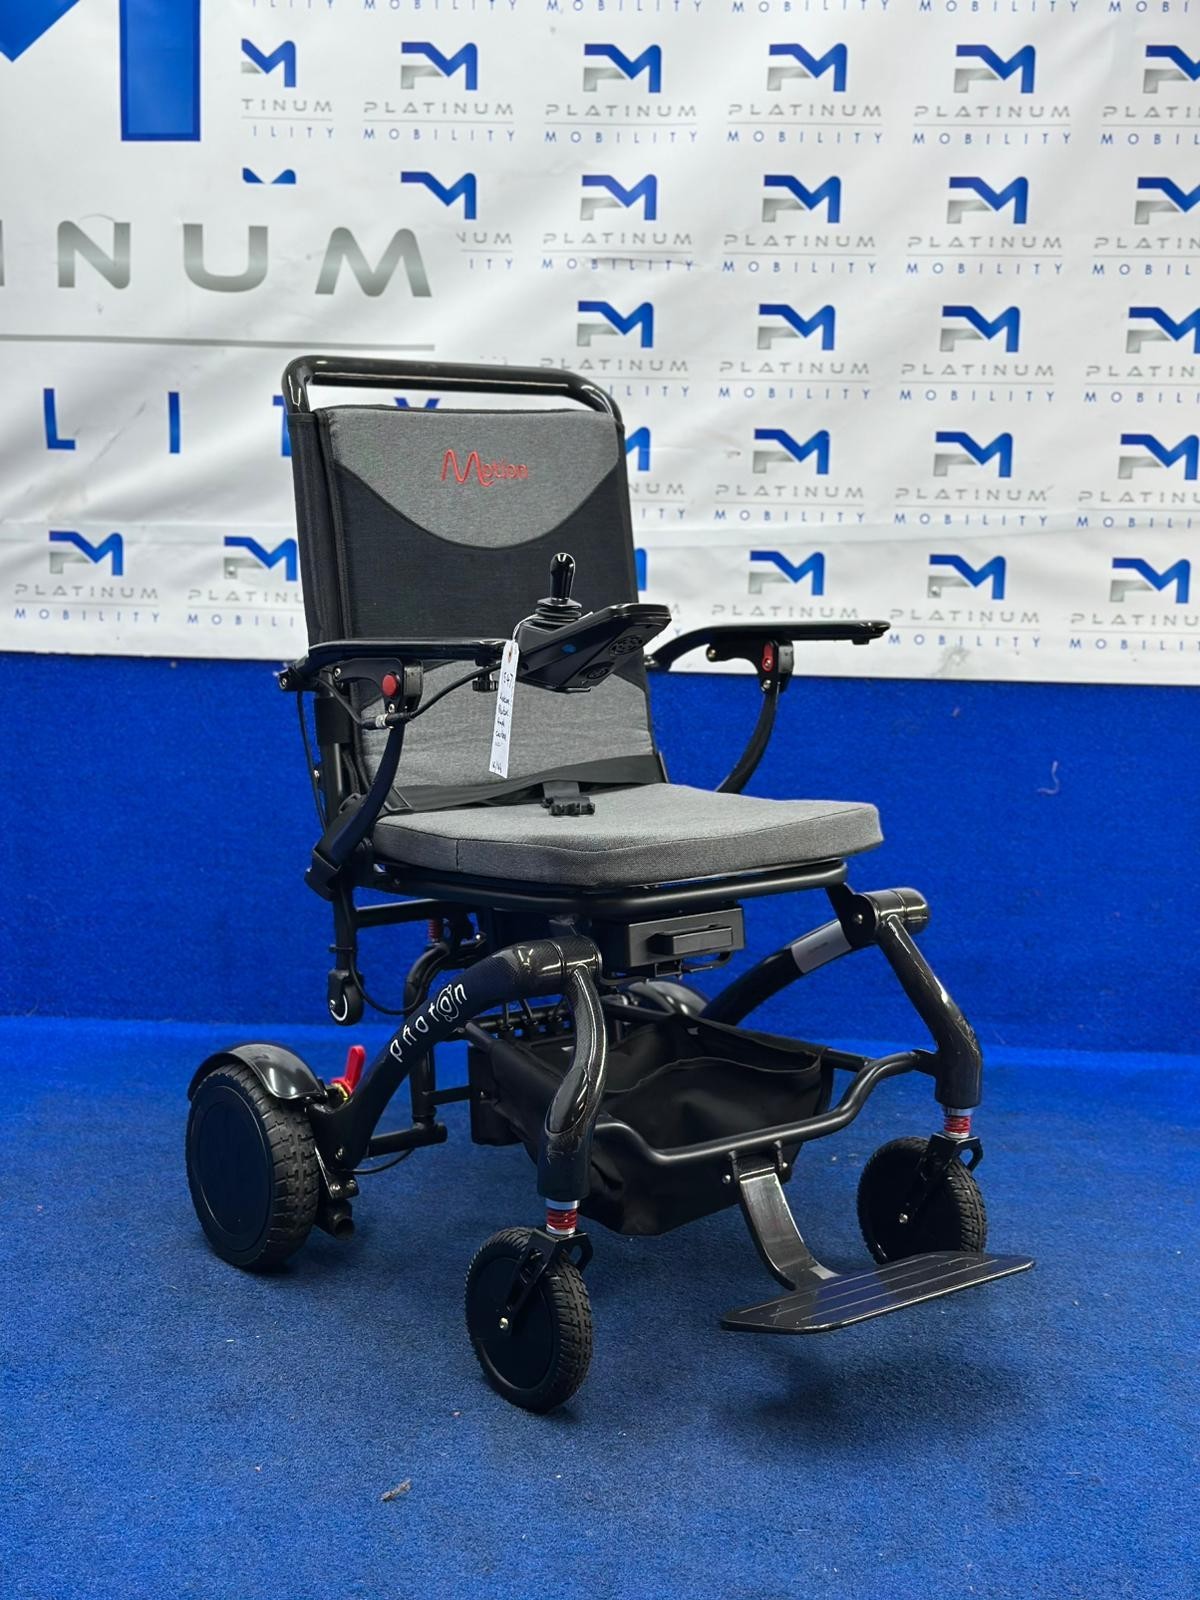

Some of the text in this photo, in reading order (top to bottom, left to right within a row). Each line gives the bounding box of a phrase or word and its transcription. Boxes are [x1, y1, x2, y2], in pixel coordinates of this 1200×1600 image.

[547, 0, 702, 14] MOBILITY
[732, 0, 889, 13] MOBILITY
[919, 0, 1078, 13] MOBILITY
[241, 98, 332, 112] TINUM
[364, 101, 513, 115] PLATINUM
[545, 104, 696, 117] PLATINUM
[728, 104, 882, 118] PLATINUM
[914, 105, 1070, 119] PLATINUM
[363, 128, 514, 141] MOBILITY
[545, 131, 697, 144] MOBILITY
[727, 130, 882, 144] MOBILITY
[912, 132, 1071, 145] MOBILITY
[543, 232, 692, 245] PLATINUM
[724, 234, 875, 248] PLATINUM
[908, 236, 1062, 249] PLATINUM
[541, 257, 695, 271] MOBILITY
[722, 261, 876, 274] MOBILITY
[906, 262, 1062, 275] MOBILITY
[540, 358, 688, 371] PLATINUM
[720, 361, 870, 374] PLATINUM
[901, 363, 1054, 376] PLATINUM
[718, 387, 870, 400] MOBILITY
[899, 389, 1054, 402] MOBILITY
[440, 448, 529, 487] Motion
[715, 484, 864, 498] PLATINUM
[895, 487, 1048, 501] PLATINUM
[715, 509, 866, 523] MOBILITY
[894, 513, 1047, 527] MOBILITY
[15, 584, 158, 599] PLATINUM
[14, 608, 159, 622] MOBILITY
[711, 604, 860, 619] PLATINUM
[889, 608, 1039, 623] PLATINUM
[888, 634, 1041, 648] MOBILITY
